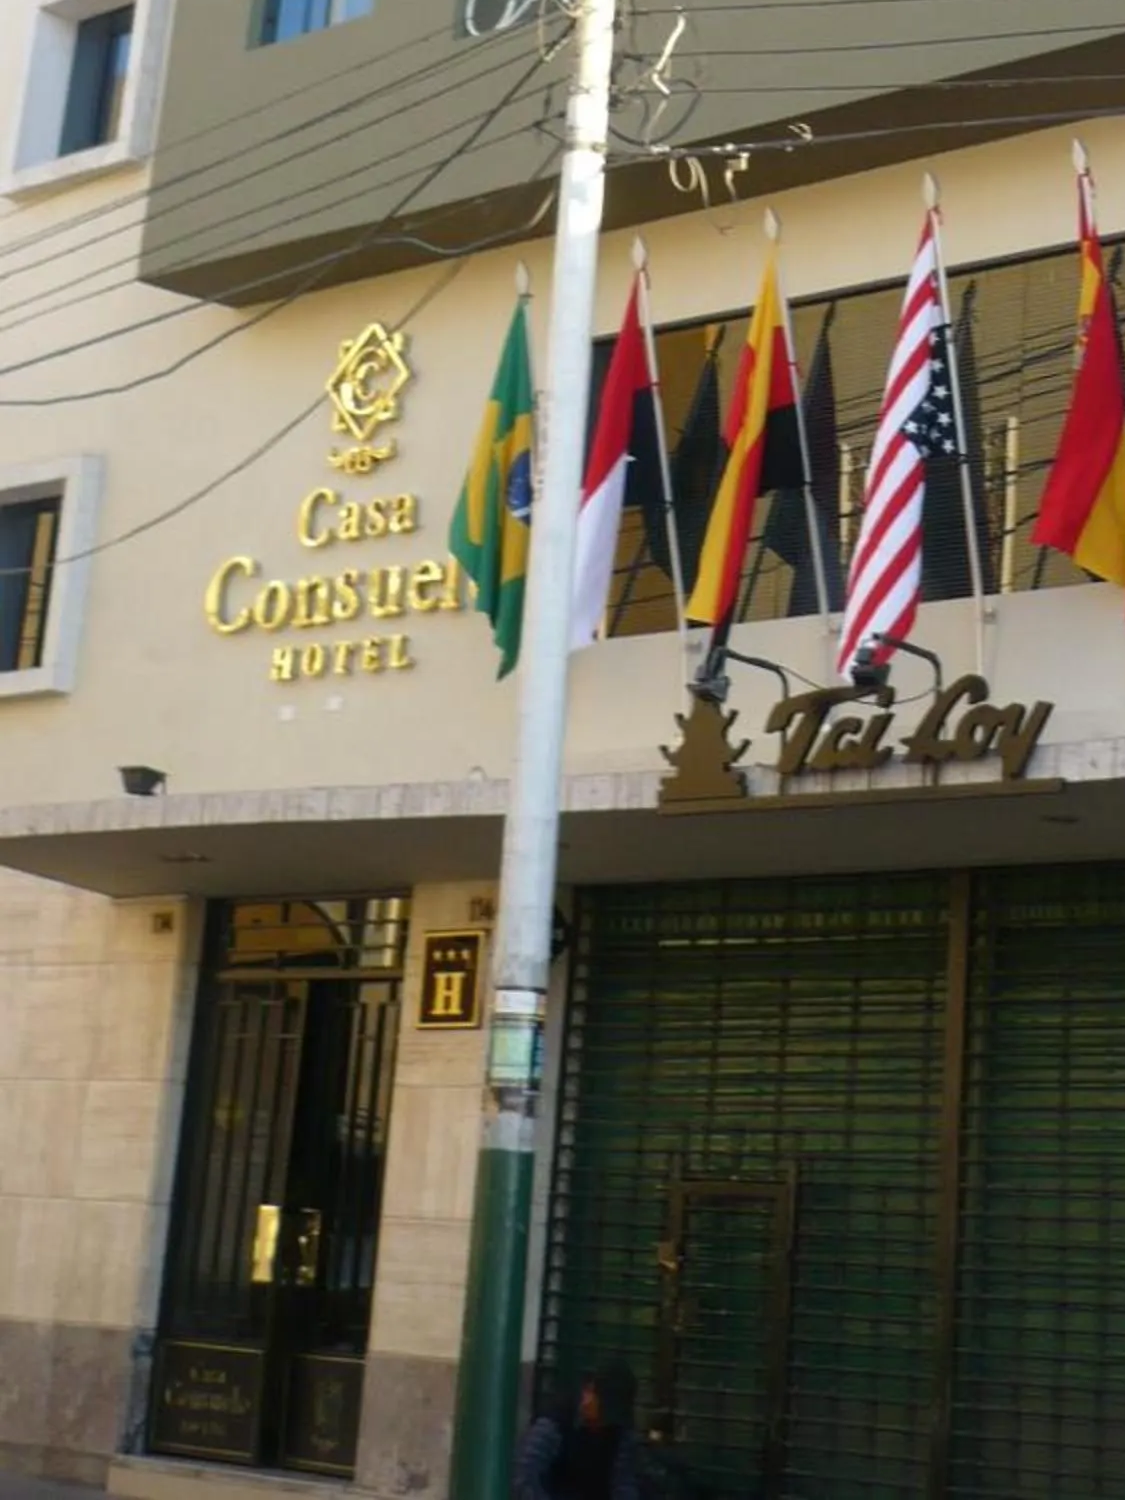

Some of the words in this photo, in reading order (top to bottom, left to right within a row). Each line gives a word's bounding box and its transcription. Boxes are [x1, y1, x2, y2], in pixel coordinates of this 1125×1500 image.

[299, 488, 416, 548] Casa
[205, 556, 479, 633] Consuel
[269, 634, 412, 681] HOTEL
[765, 685, 896, 774] Tai
[901, 674, 1055, 779] Loy
[430, 971, 466, 1015] H
